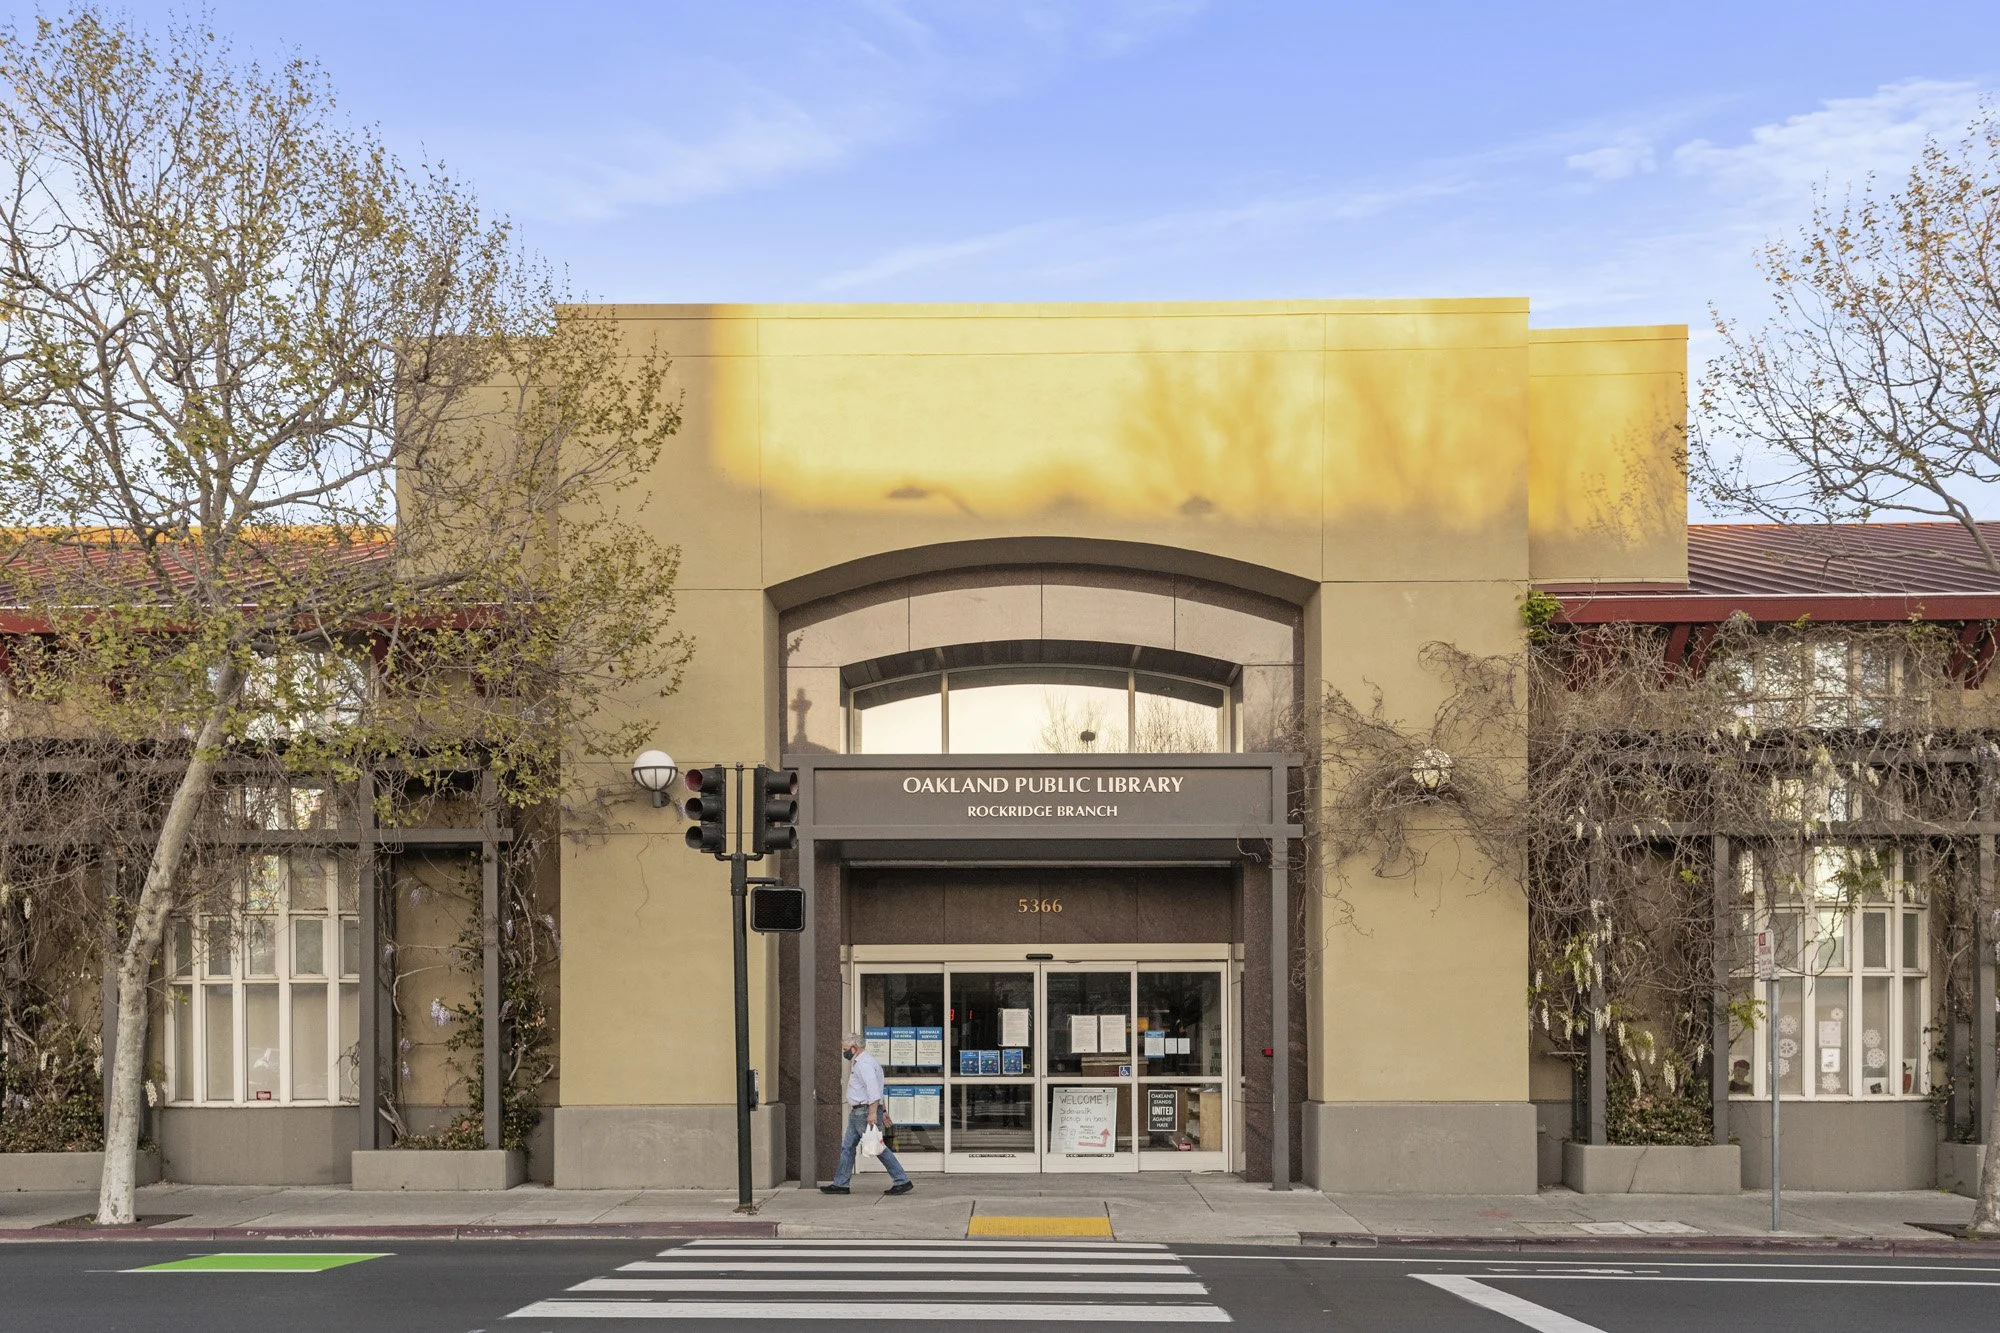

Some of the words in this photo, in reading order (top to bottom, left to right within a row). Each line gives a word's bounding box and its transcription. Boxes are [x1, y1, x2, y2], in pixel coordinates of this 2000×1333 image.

[903, 777, 1009, 793] OAKLAND
[1015, 776, 1091, 793] PUBLIC
[1097, 776, 1183, 793] LIBRARY
[967, 805, 1053, 817] ROCKRIDGE
[1057, 805, 1118, 817] BRANCH
[1018, 898, 1063, 913] 5366
[1152, 1106, 1174, 1115] UNITED
